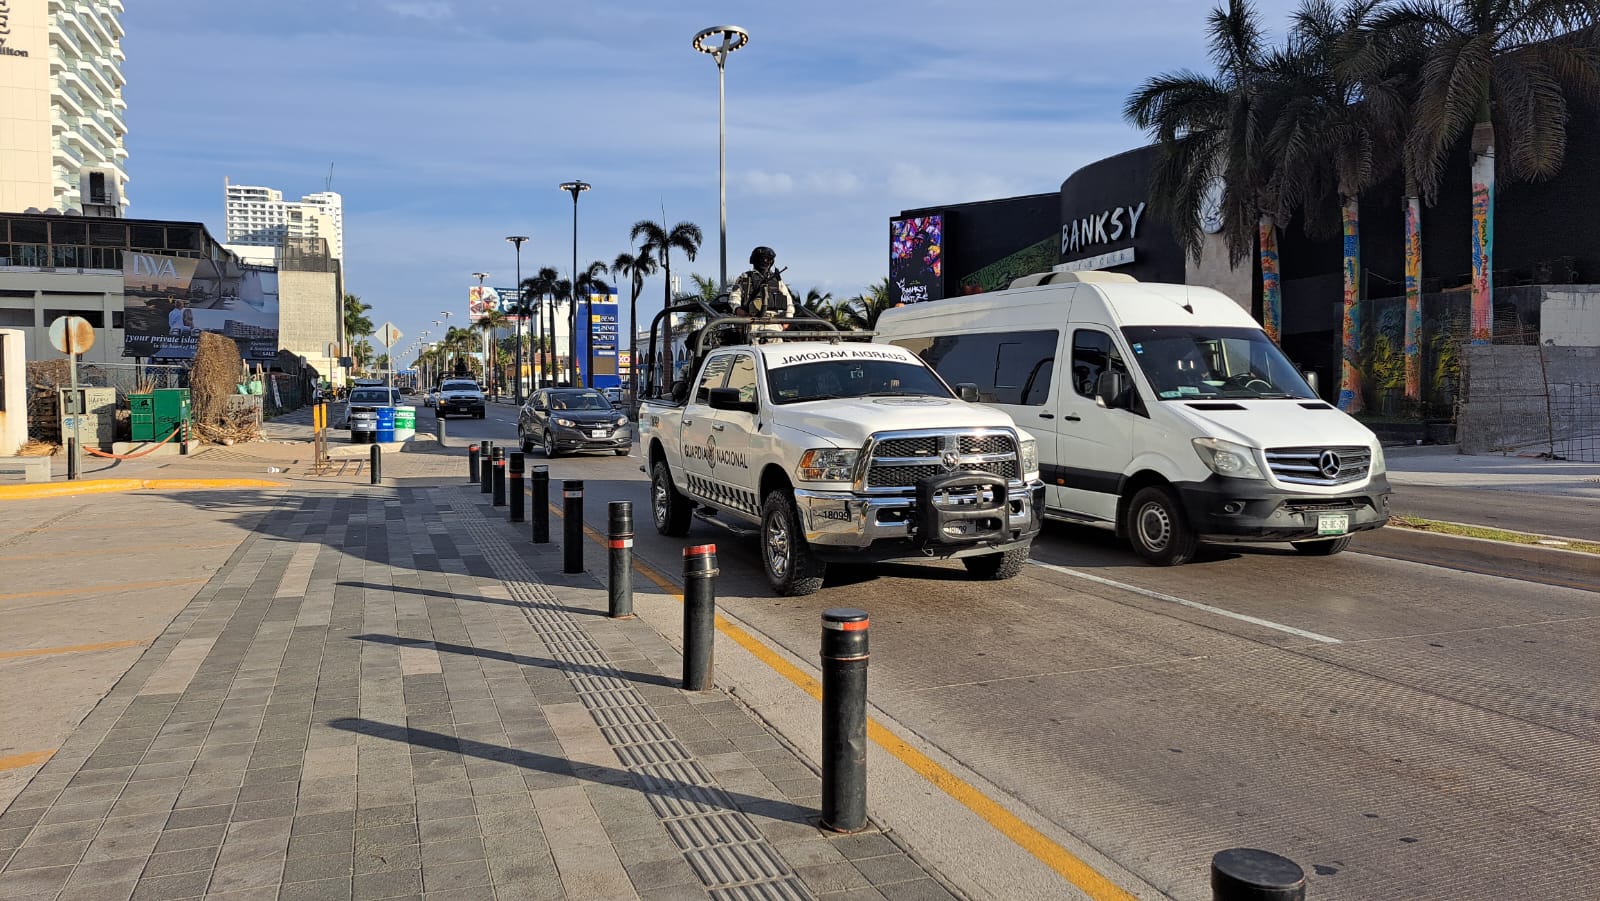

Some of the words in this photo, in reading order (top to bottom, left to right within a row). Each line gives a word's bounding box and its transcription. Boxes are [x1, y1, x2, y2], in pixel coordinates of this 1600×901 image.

[1062, 202, 1145, 255] BANKSY
[150, 334, 179, 344] private
[716, 448, 748, 469] NACIONAL
